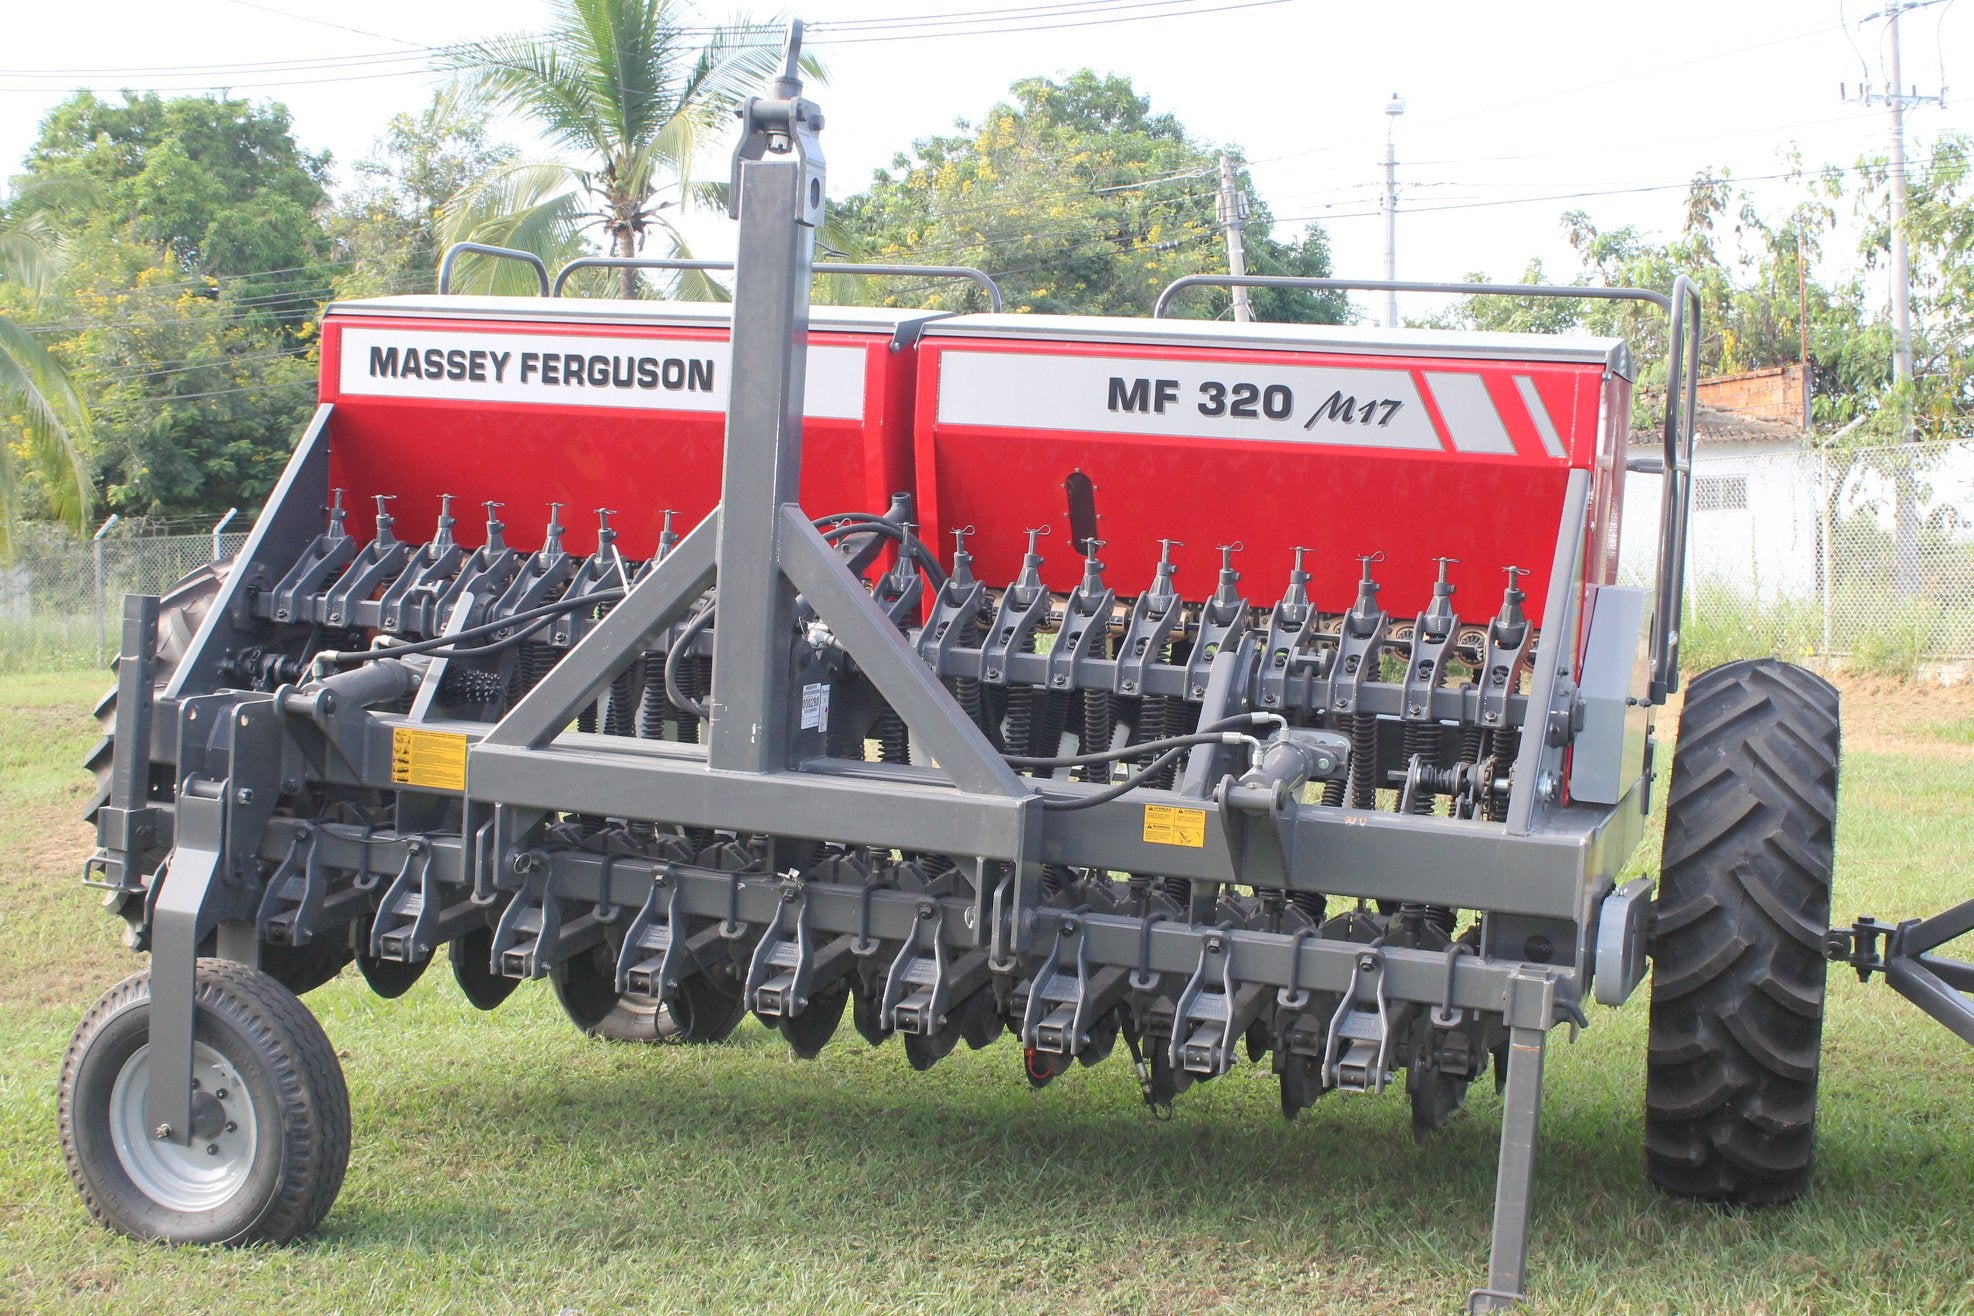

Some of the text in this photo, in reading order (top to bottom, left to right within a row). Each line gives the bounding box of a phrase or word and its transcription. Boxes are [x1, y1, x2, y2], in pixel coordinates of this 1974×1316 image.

[369, 346, 715, 393] MASSEY FERGUSON
[1107, 377, 1404, 430] MF 320 M17
